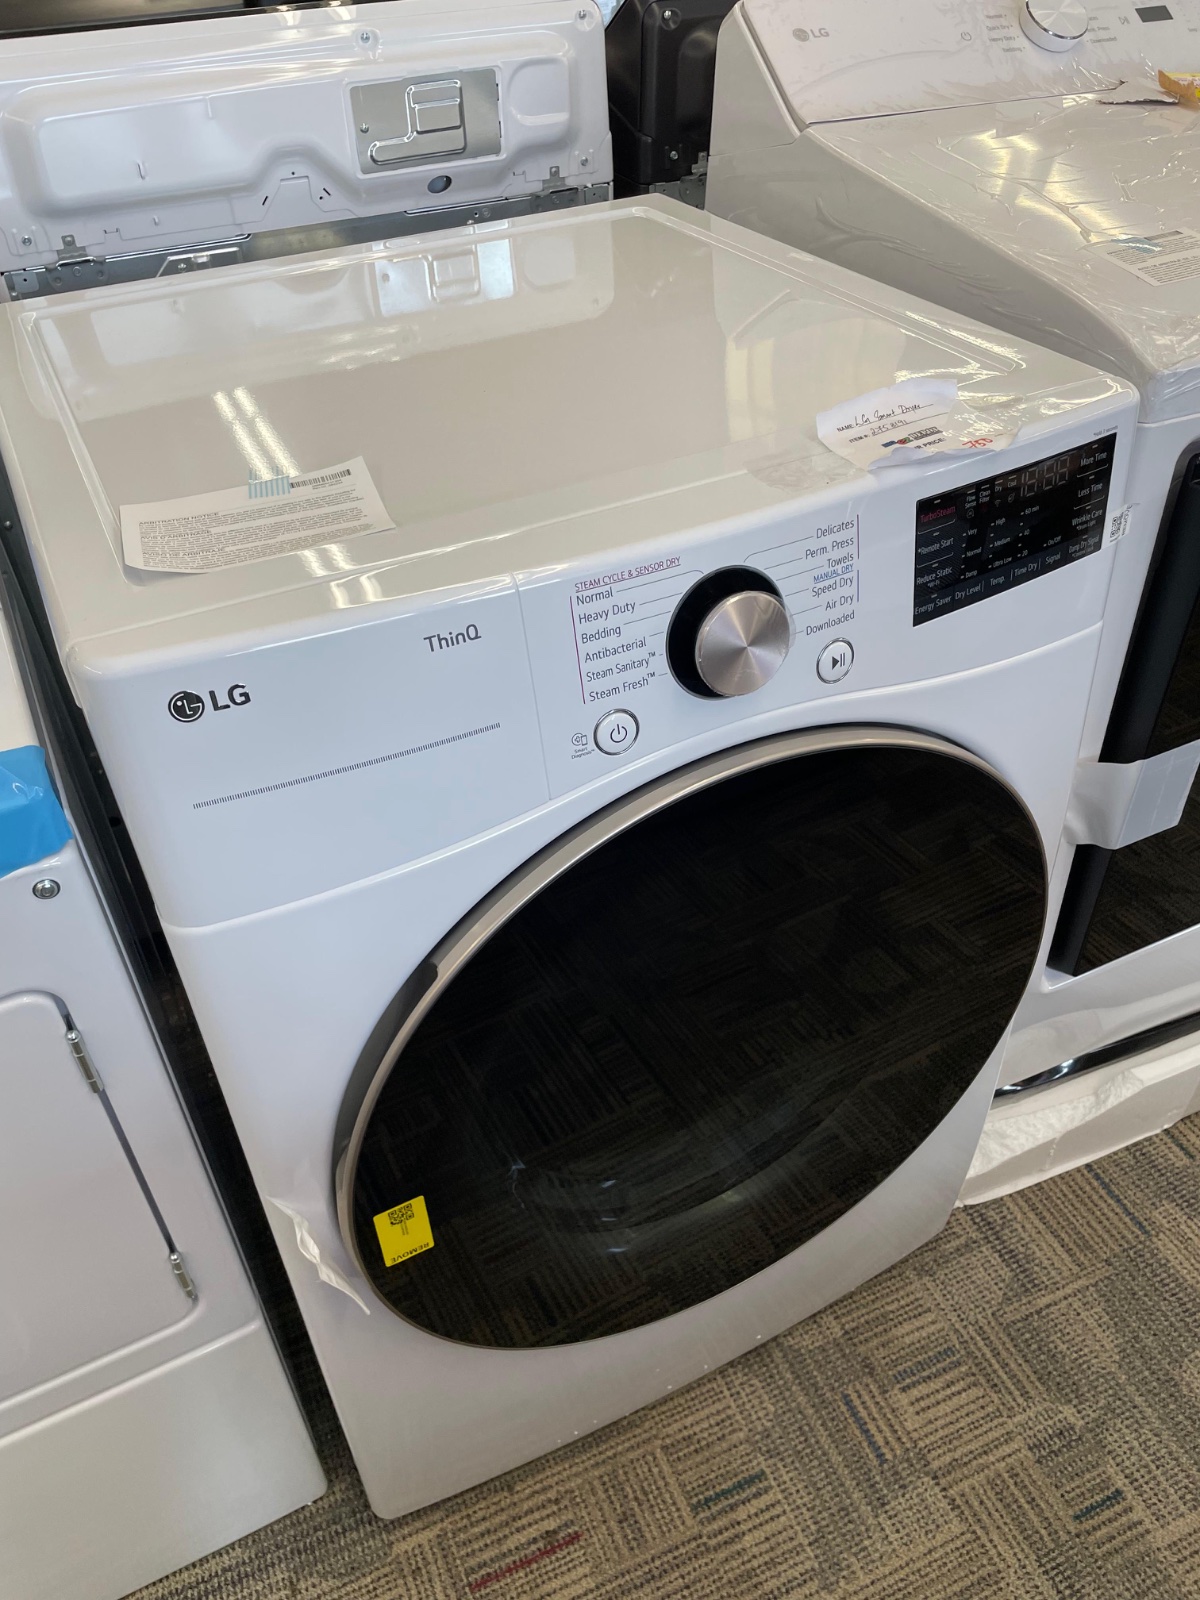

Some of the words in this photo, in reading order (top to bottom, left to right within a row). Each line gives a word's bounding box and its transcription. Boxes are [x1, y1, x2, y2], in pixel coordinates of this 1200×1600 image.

[810, 28, 830, 38] LG
[1095, 452, 1108, 462] Time
[1077, 487, 1090, 498] Less
[1090, 482, 1103, 493] Time
[920, 506, 956, 523] TurboSteam
[995, 517, 1006, 527] High
[1071, 513, 1091, 527] Wrinkle
[1091, 509, 1103, 519] Care
[816, 519, 855, 539] Delicates
[967, 528, 978, 536] Very
[805, 546, 830, 560] Perm.
[831, 537, 854, 552] Press
[940, 537, 954, 549] Start
[966, 546, 983, 558] Normal
[827, 552, 854, 569] Towels
[1021, 549, 1029, 558] 20
[1045, 551, 1061, 566] Signal
[574, 579, 601, 592] STEAM
[602, 571, 626, 585] CYCLE
[627, 569, 634, 578] &
[635, 560, 664, 576] SENSOR
[665, 556, 681, 568] DRY
[813, 568, 841, 583] MANUAL
[841, 563, 854, 574] DRY
[916, 573, 936, 586] Reduce
[936, 566, 953, 579] Static
[965, 569, 978, 579] Damp
[1014, 566, 1028, 577] Time
[1028, 562, 1038, 572] Dry
[811, 581, 838, 598] Speed
[839, 575, 854, 588] Dry
[955, 590, 966, 600] Dry
[966, 583, 981, 596] Level
[576, 586, 614, 606] Normal
[825, 598, 838, 612] Air
[839, 593, 855, 606] Dry
[914, 602, 935, 615] Energy
[935, 595, 952, 608] Saver
[578, 609, 609, 625] Heavy
[612, 602, 636, 616] Duty
[806, 610, 855, 636] Downloaded
[423, 623, 482, 653] ThinQ
[581, 626, 622, 644] Bedding
[584, 636, 647, 664] Antibacterial
[586, 667, 614, 683] Steam
[208, 683, 252, 712] LG
[589, 685, 621, 702] Steam
[391, 1242, 430, 1264] REMOVE
